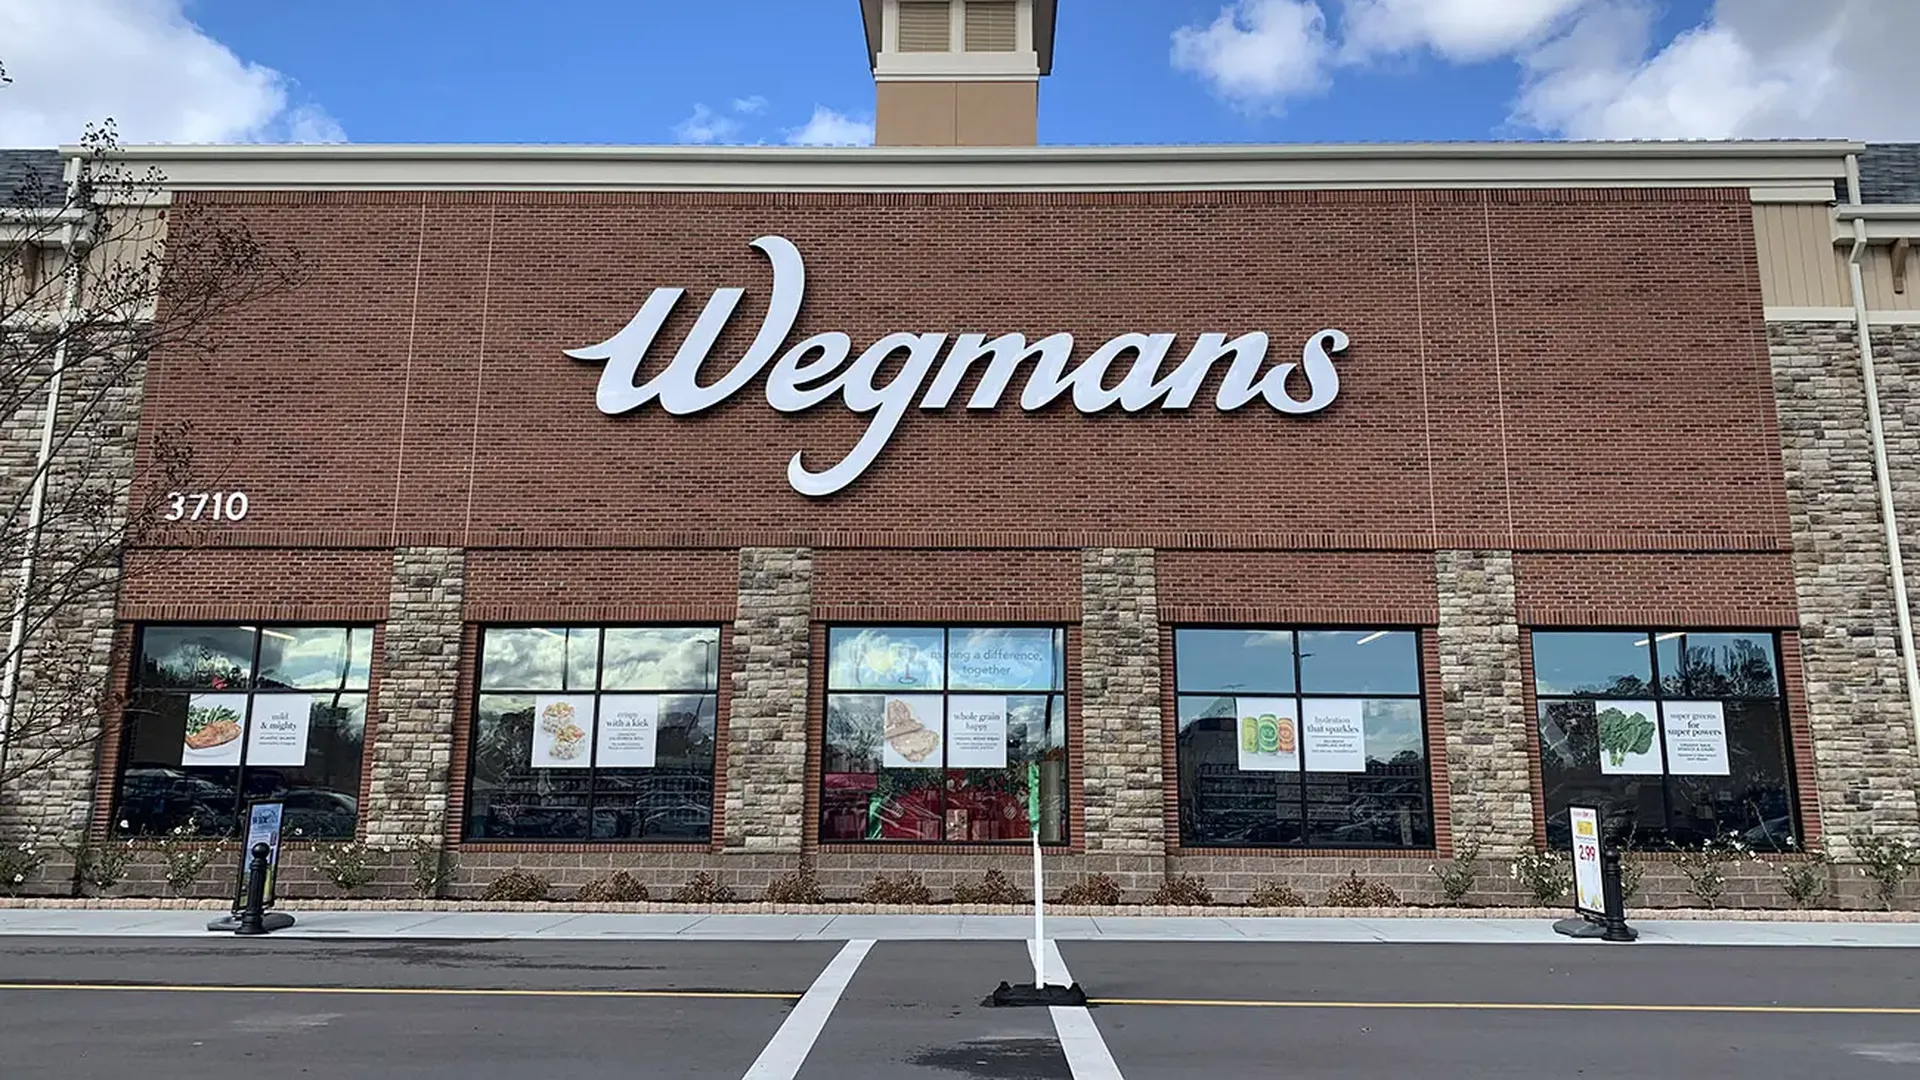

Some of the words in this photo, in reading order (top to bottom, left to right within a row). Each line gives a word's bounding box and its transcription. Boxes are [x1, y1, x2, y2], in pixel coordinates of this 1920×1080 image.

[562, 234, 1350, 497] Wegmans
[164, 491, 249, 521] 3710
[973, 651, 981, 660] a
[983, 648, 1044, 662] difference,
[963, 664, 1011, 676] together
[271, 712, 289, 720] mild
[953, 711, 977, 721] whole
[978, 711, 1001, 722] grain
[1314, 716, 1351, 725] hydration
[1670, 713, 1690, 721] super
[260, 721, 267, 729] &
[269, 720, 297, 731] mighty
[606, 718, 624, 727] with
[632, 718, 649, 727] kick
[965, 721, 988, 732] happy
[1687, 720, 1700, 728] for
[1307, 724, 1324, 732] that
[1325, 725, 1360, 735] sparkles
[1667, 729, 1691, 737] super
[1692, 729, 1722, 738] powers
[1579, 844, 1595, 862] 2.99
